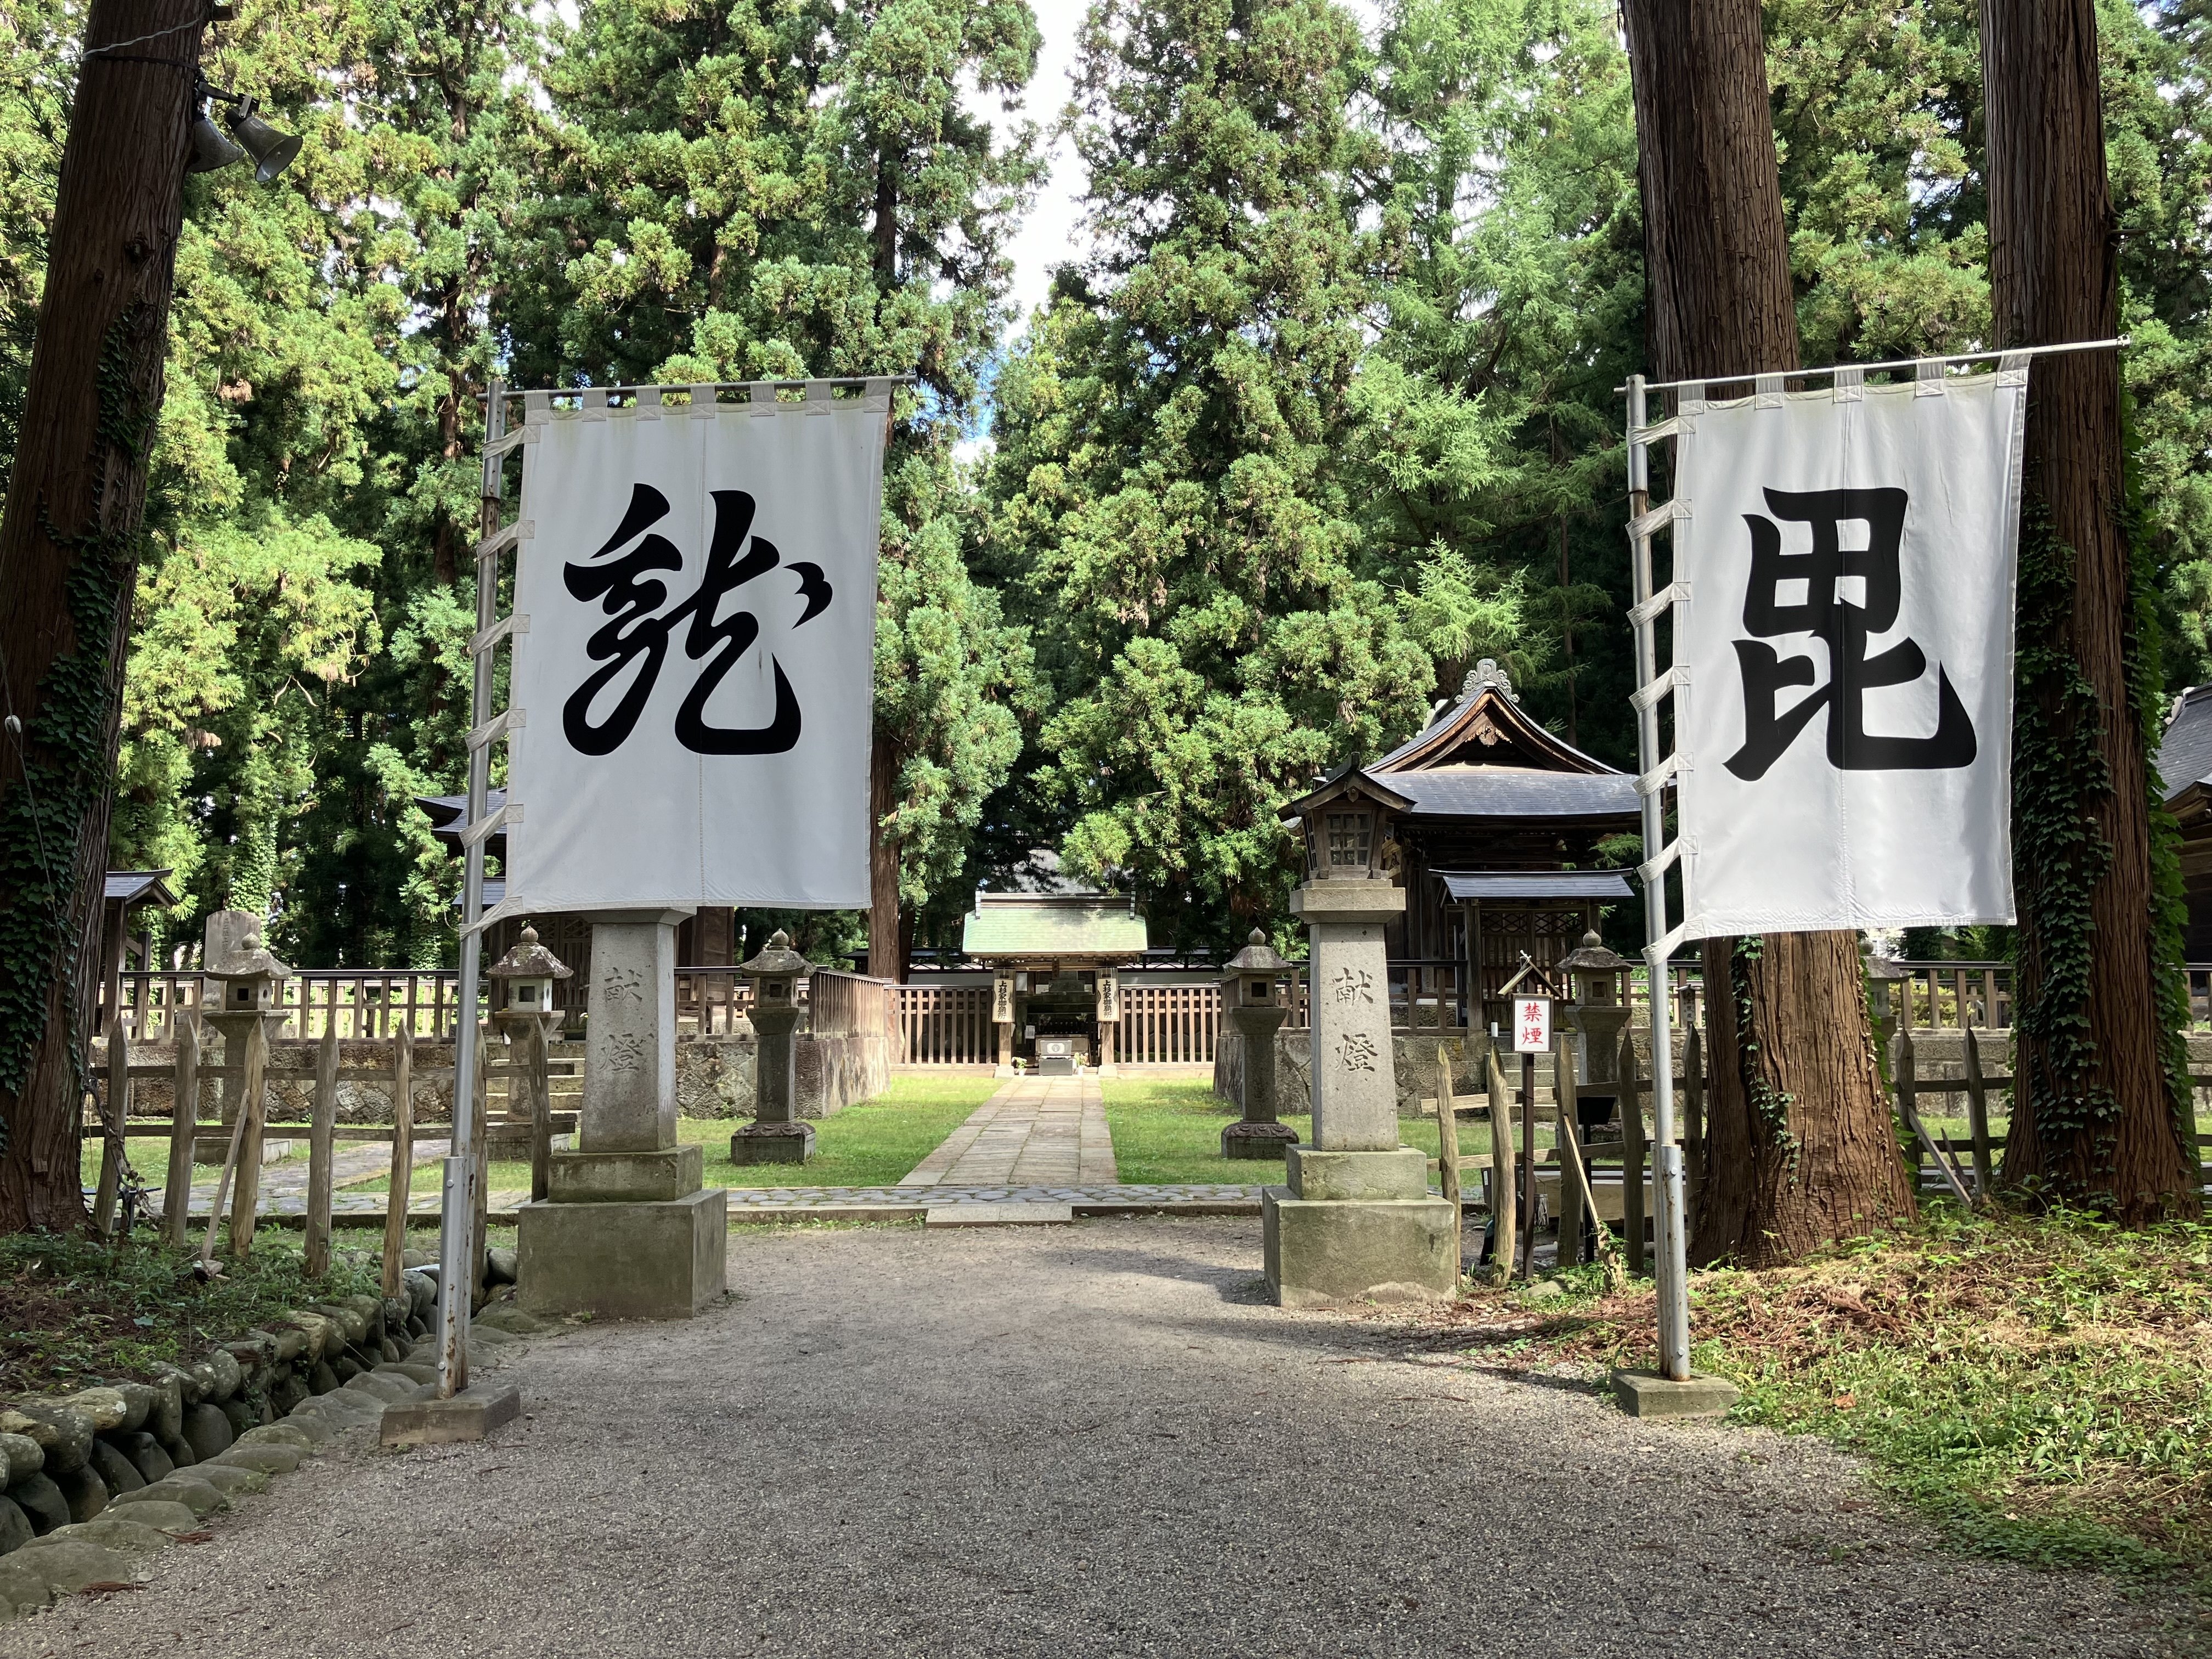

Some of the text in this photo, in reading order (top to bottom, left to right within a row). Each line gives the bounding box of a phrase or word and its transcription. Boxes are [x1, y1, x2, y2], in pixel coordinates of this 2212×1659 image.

[1722, 486, 1978, 782] 毘
[1332, 967, 1378, 1072] 献燈
[1521, 1001, 1543, 1045] 禁煙
